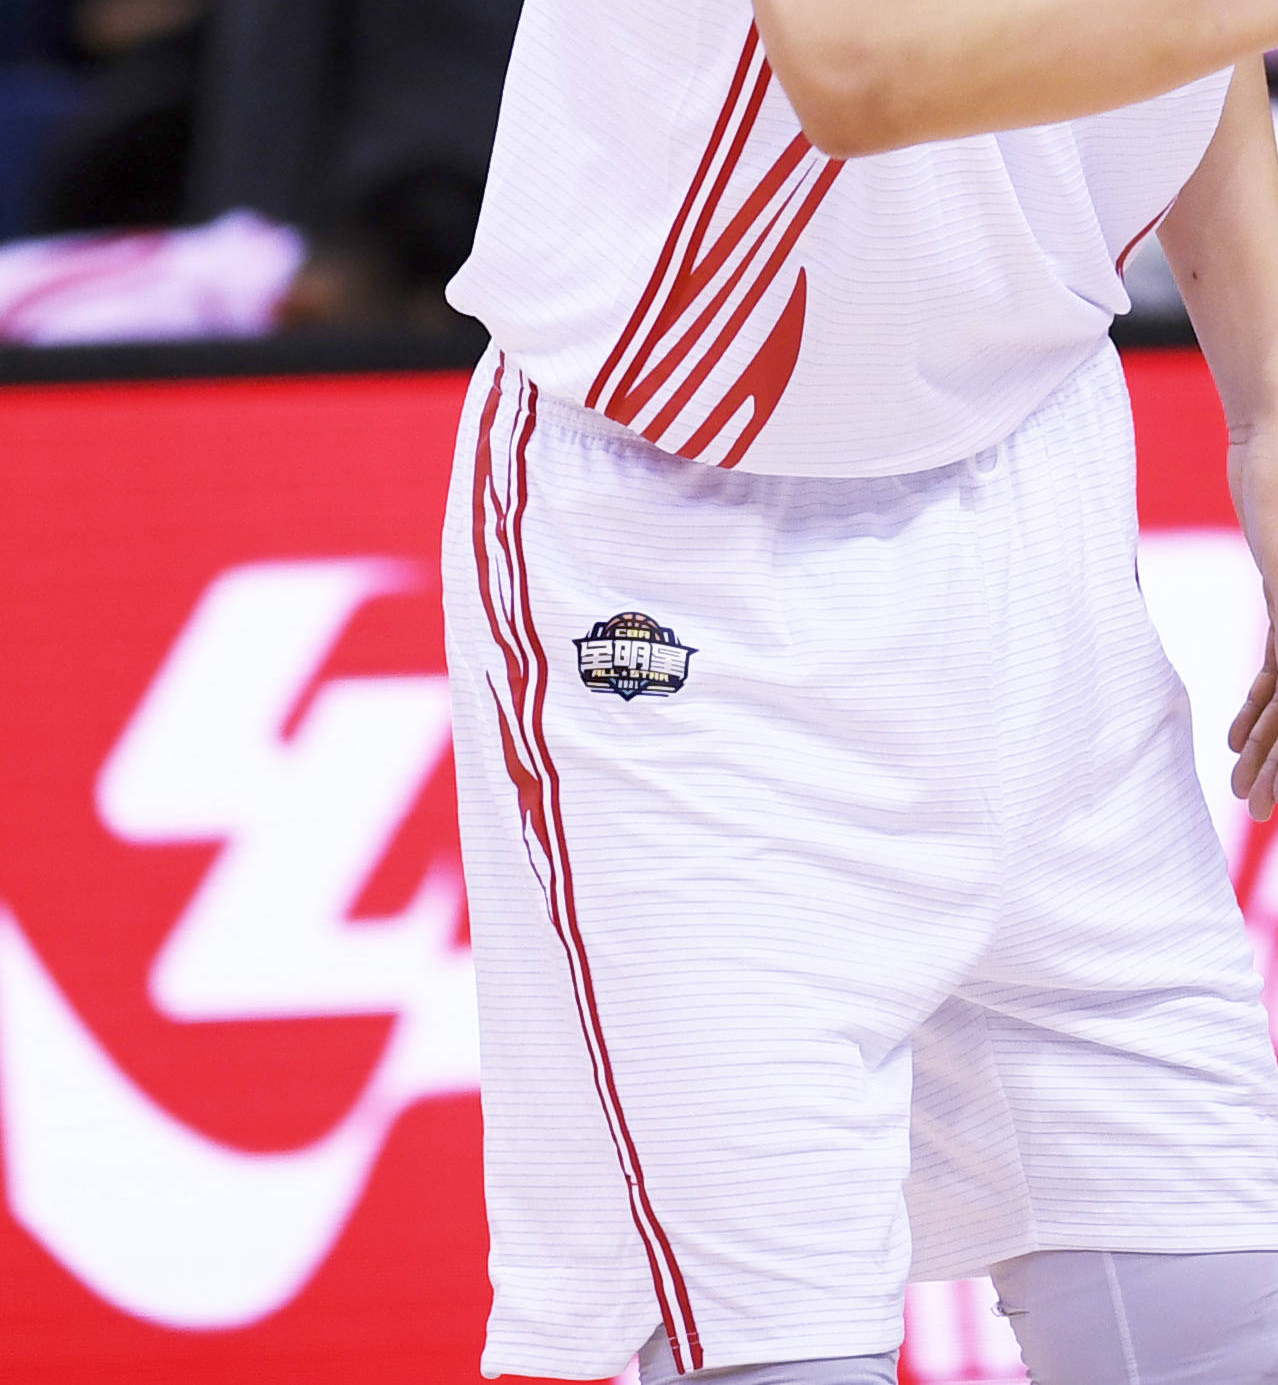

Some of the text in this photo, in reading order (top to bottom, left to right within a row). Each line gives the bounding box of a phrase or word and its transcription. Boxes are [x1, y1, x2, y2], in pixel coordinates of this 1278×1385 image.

[579, 639, 690, 680] 全明星
[591, 669, 670, 684] ALL STAR
